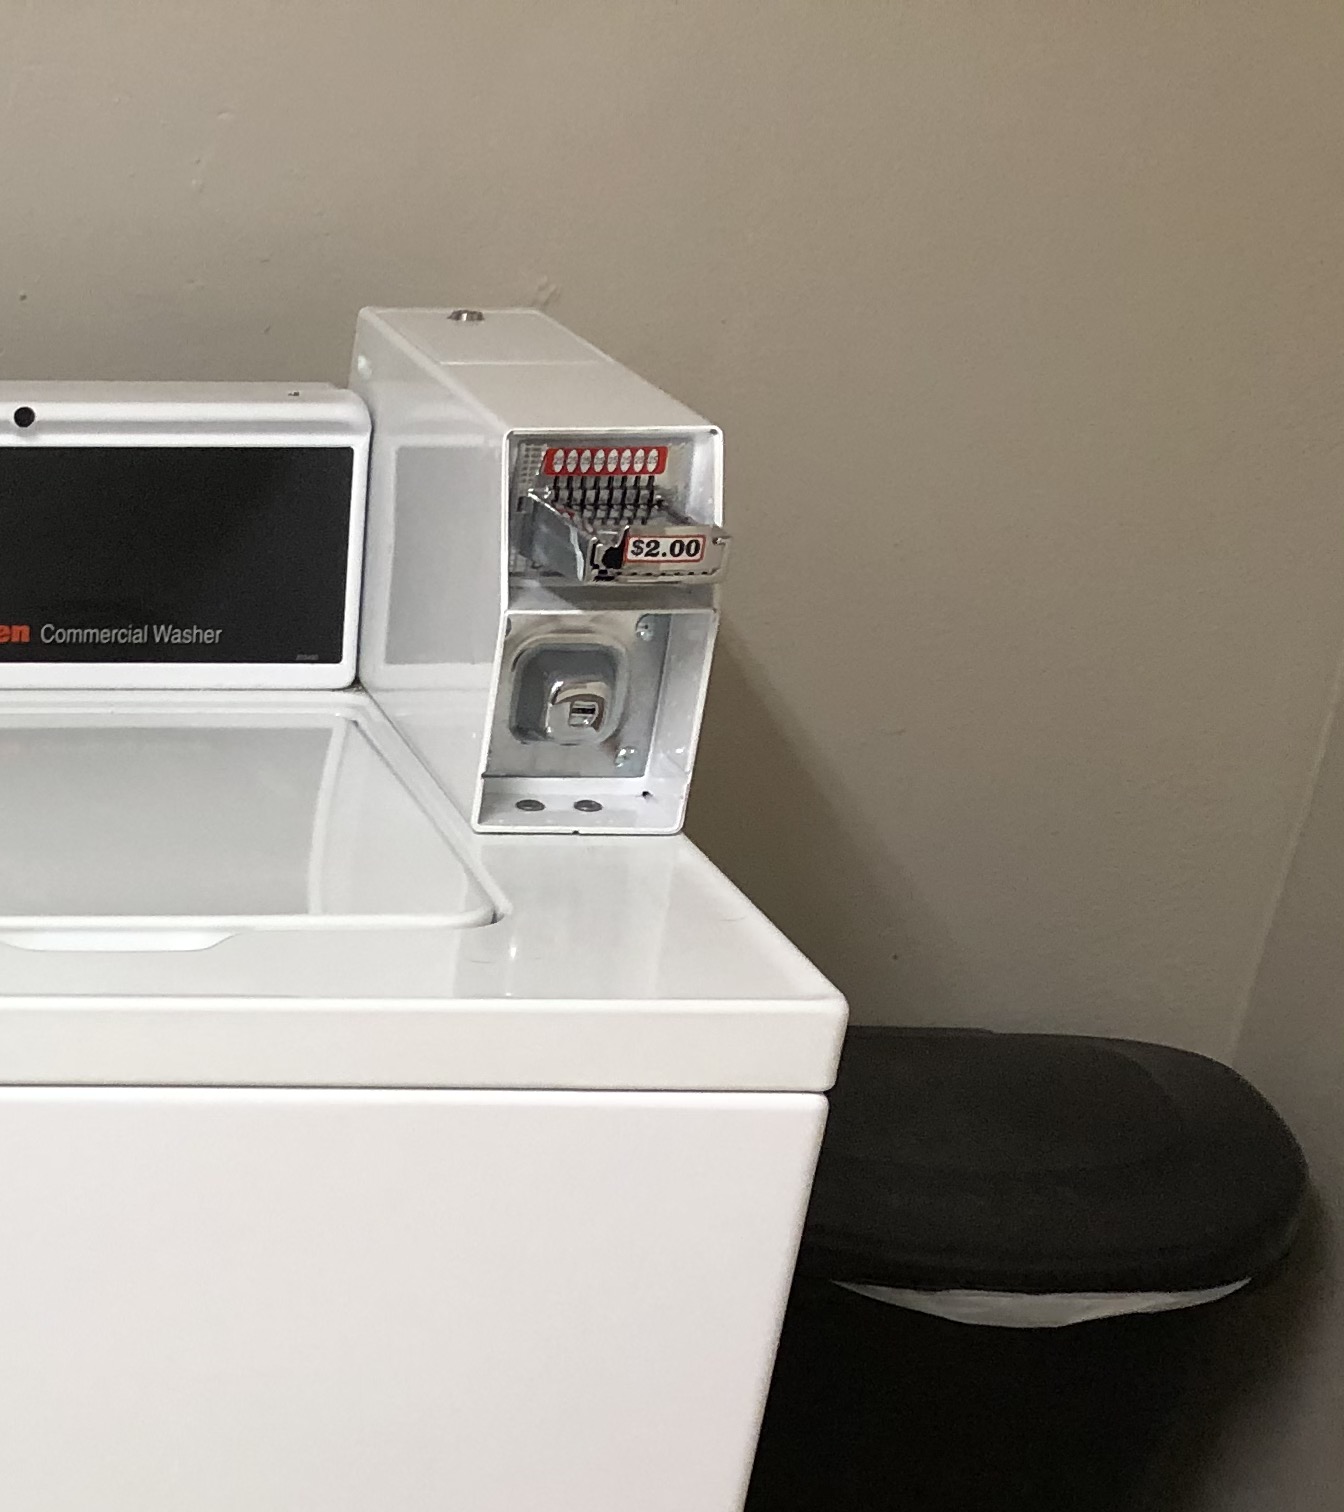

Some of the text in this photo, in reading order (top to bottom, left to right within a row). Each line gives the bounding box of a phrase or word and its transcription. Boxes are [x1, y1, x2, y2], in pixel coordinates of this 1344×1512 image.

[630, 539, 701, 557] $2.00
[40, 624, 148, 644] Commercial
[153, 625, 222, 644] Washer
